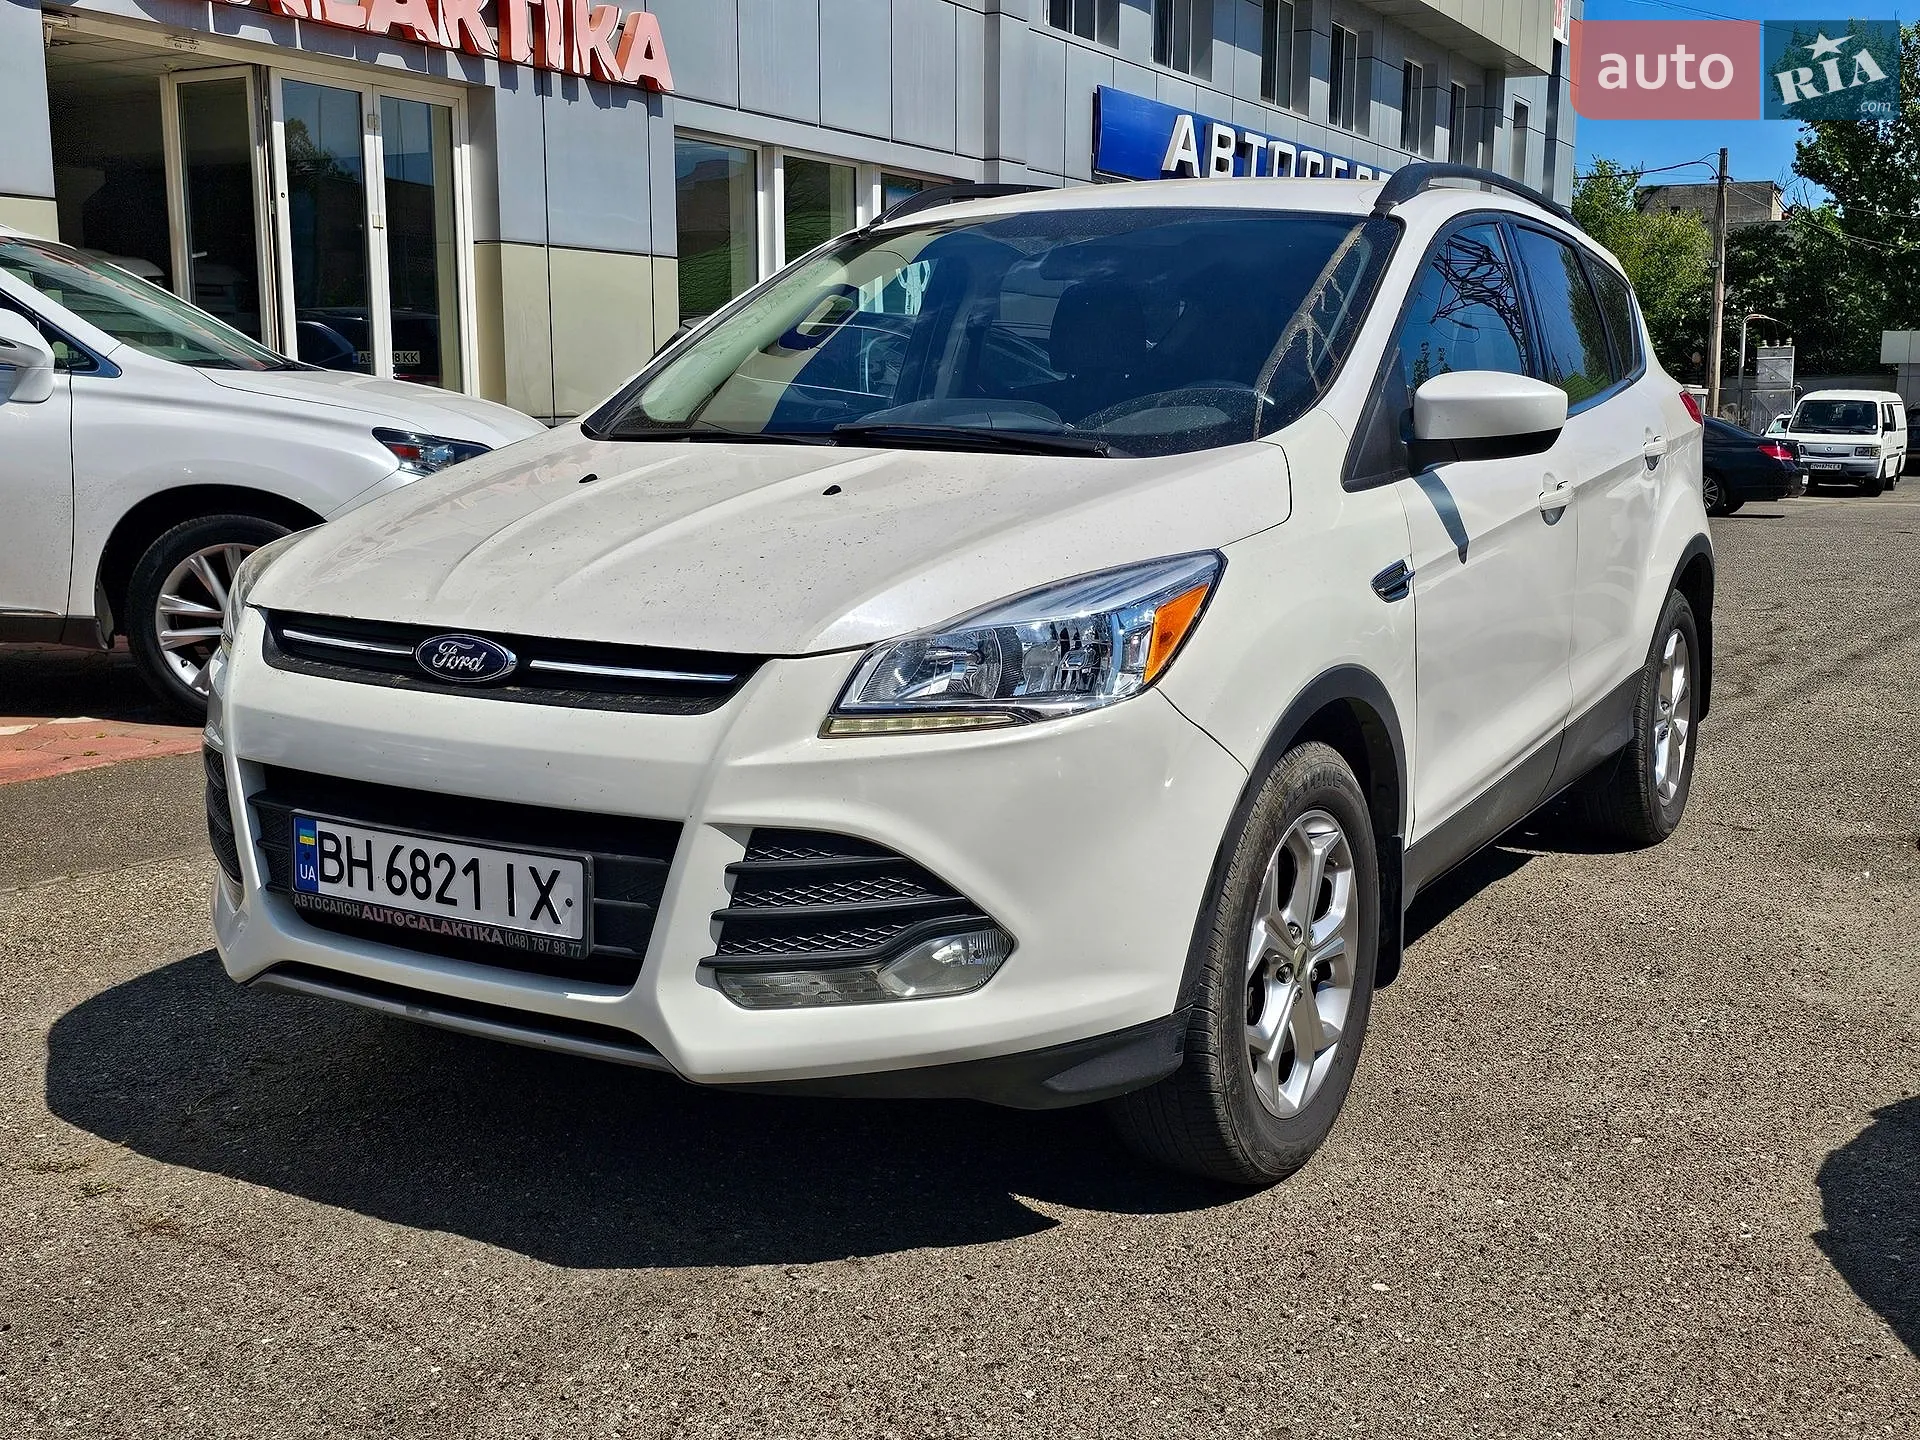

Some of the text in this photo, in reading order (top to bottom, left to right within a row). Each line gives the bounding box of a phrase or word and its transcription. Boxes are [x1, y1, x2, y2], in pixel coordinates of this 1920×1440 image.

[432, 640, 487, 672] Ford
[299, 864, 317, 882] UA
[317, 830, 563, 925] BH 6821 IX
[293, 893, 361, 917] АВТОСАЛОН
[361, 904, 504, 946] AUTOGALAKTIKA
[504, 932, 583, 958] (048) 787 98 77
